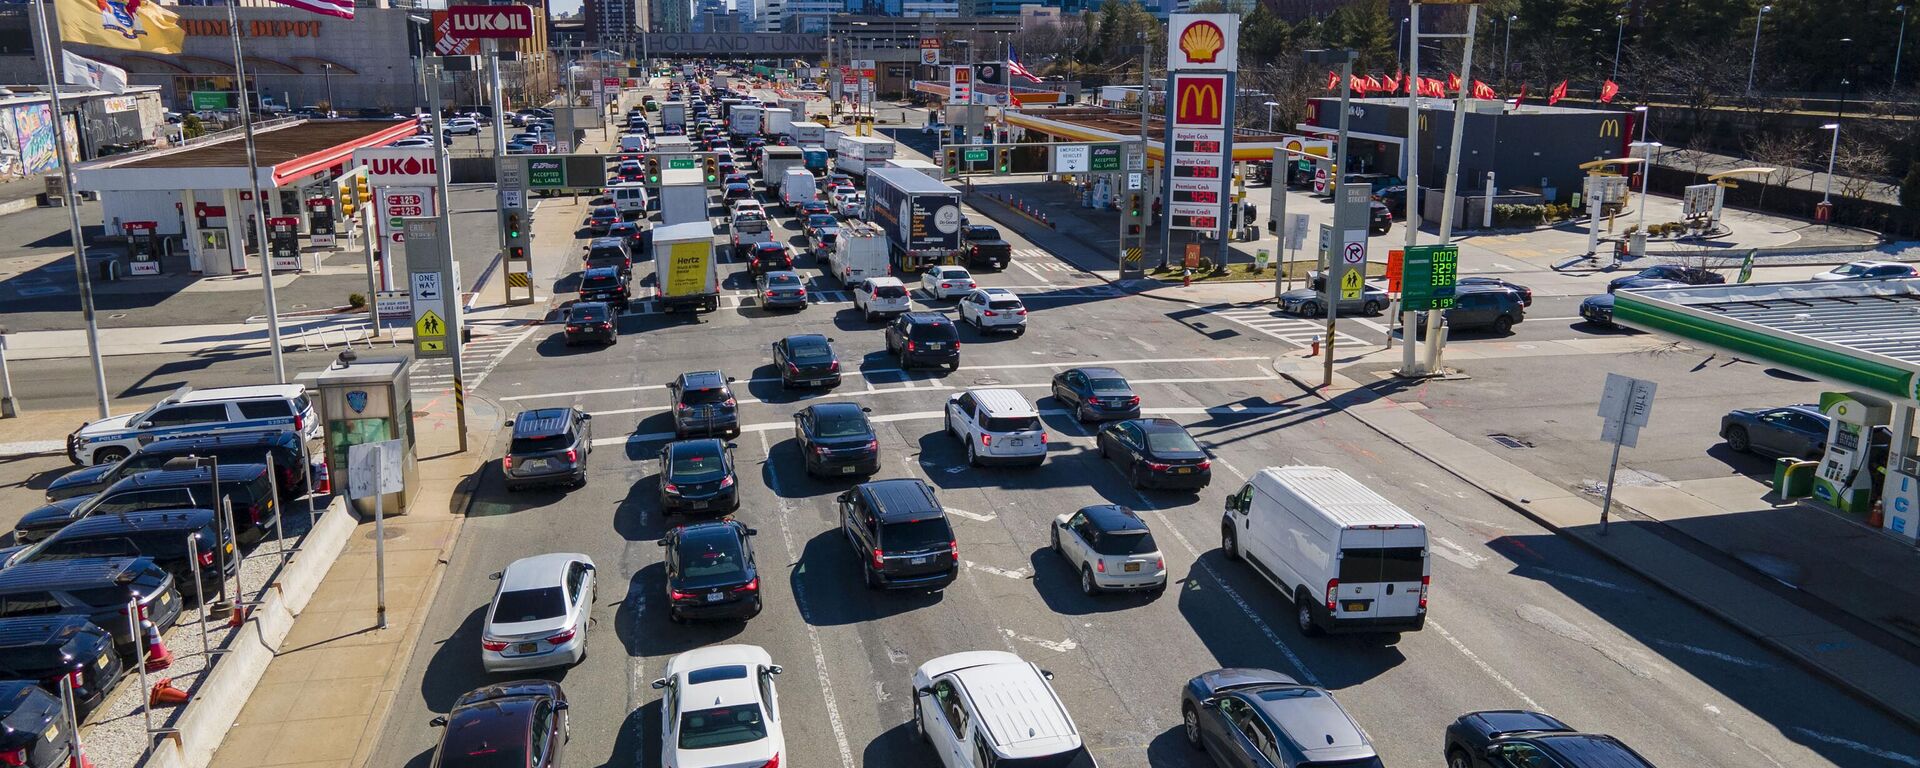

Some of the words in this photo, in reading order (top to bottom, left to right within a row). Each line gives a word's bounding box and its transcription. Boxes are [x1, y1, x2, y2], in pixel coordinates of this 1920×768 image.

[252, 20, 322, 38] DEPOT
[453, 12, 528, 30] LUKOIL
[649, 36, 749, 50] HOLLAND
[99, 434, 122, 442] POLICE
[1892, 477, 1910, 533] ICE
